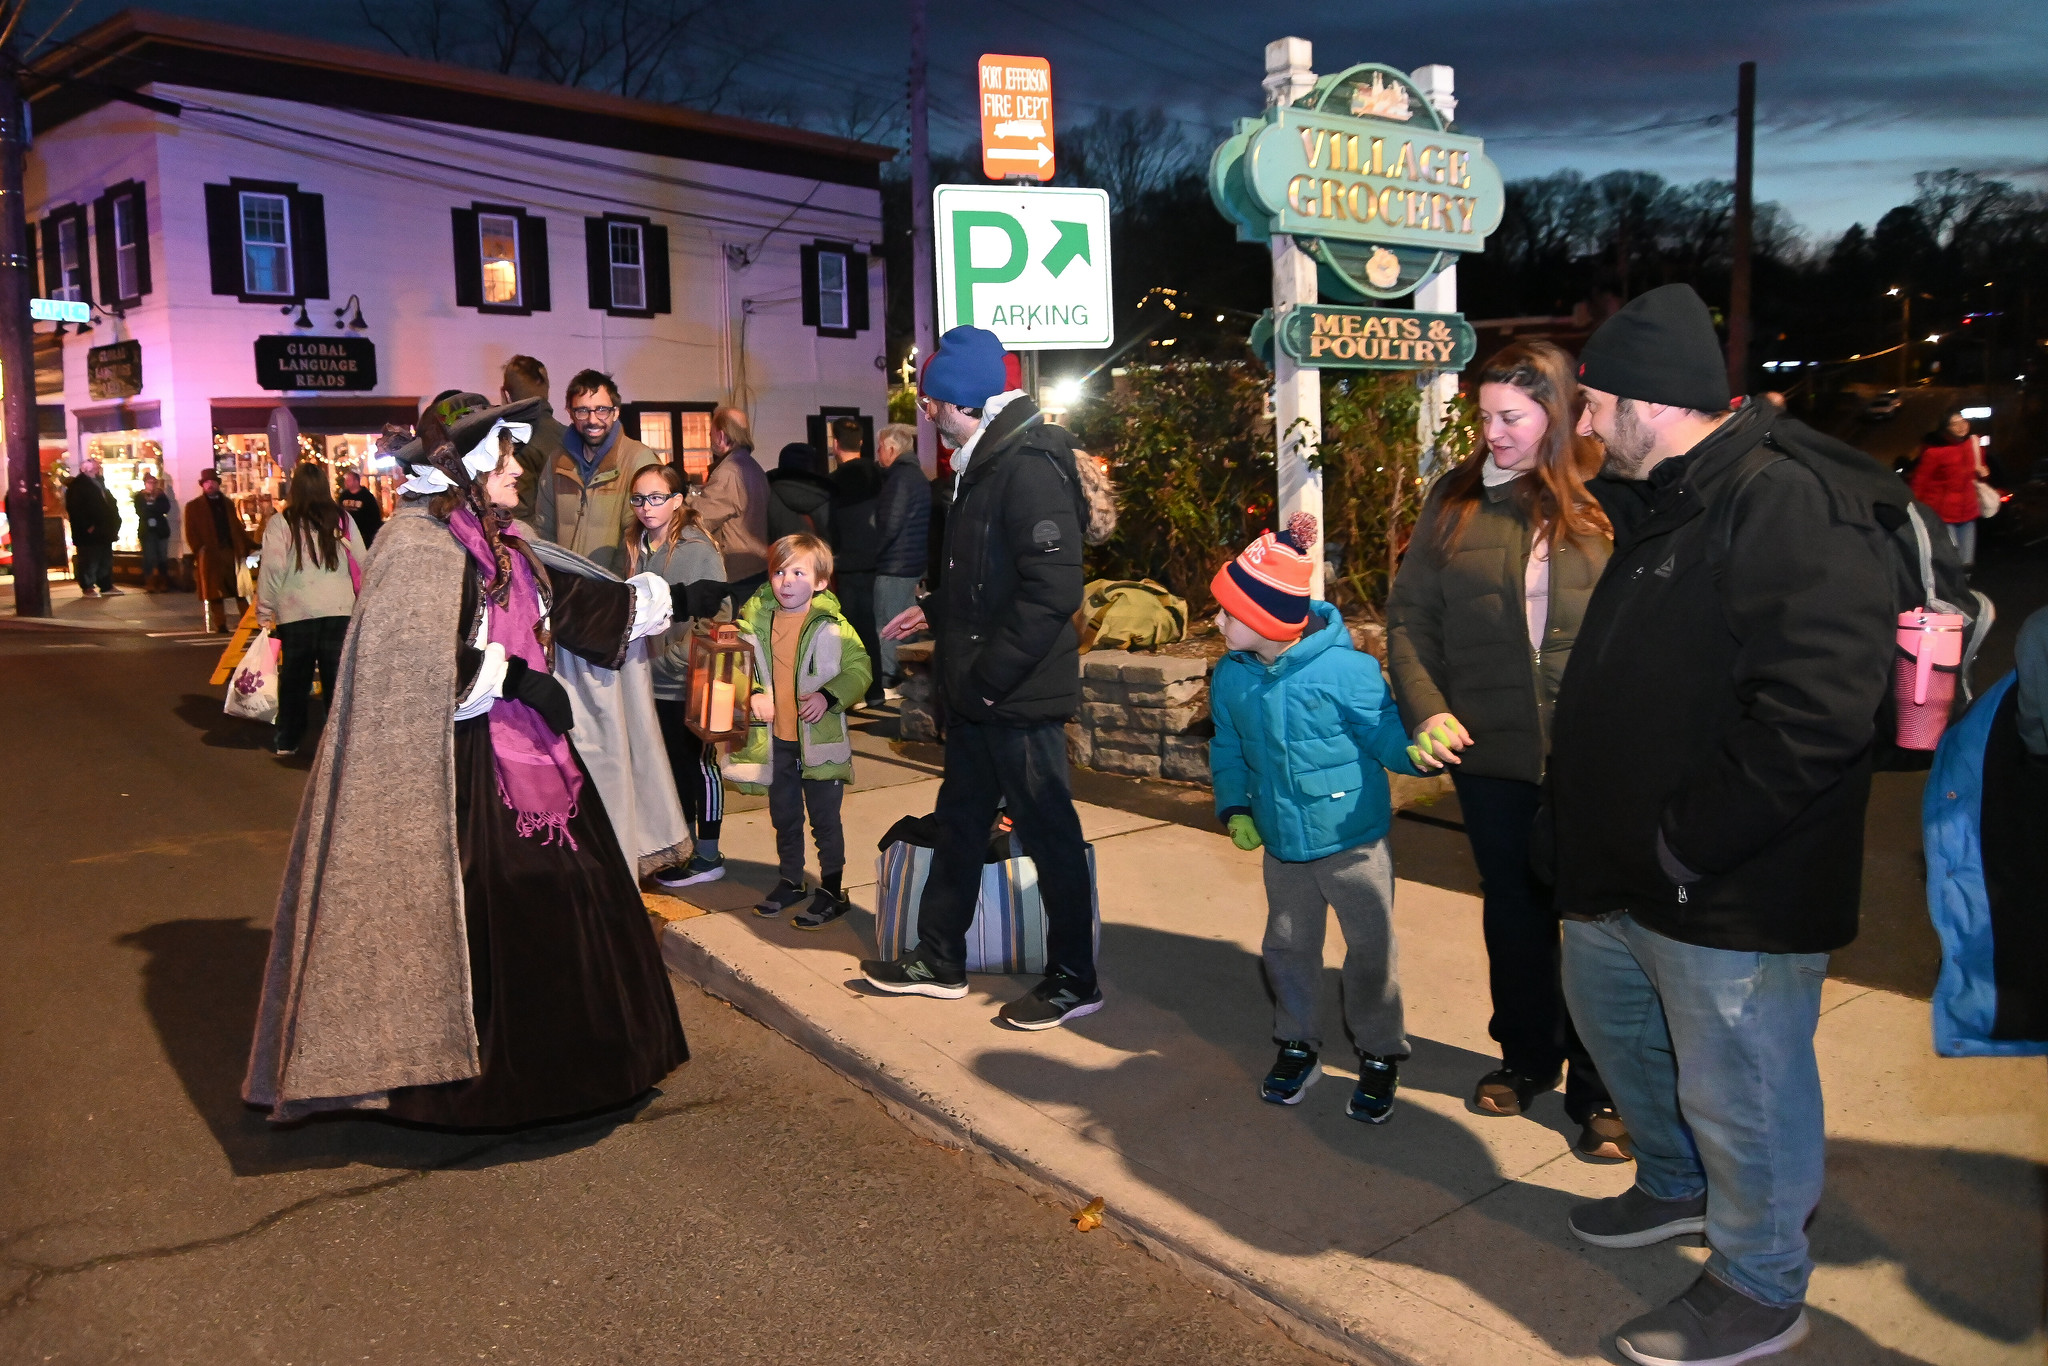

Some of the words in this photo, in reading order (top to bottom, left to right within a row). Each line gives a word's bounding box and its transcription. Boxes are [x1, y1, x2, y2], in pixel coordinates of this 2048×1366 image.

[982, 66, 1003, 89] PORT
[1005, 67, 1048, 92] JEFFERSON
[984, 93, 1012, 118] FIRE
[1016, 95, 1049, 120] DEPT
[1297, 126, 1471, 190] VILLAGE
[1288, 174, 1479, 234] GROCERY
[1311, 313, 1422, 340] MEATS
[1428, 320, 1453, 342] &
[287, 343, 346, 356] GLOBAL
[1310, 336, 1456, 362] POULTRY
[279, 358, 358, 372] LANGUAGE
[295, 374, 346, 387] READS
